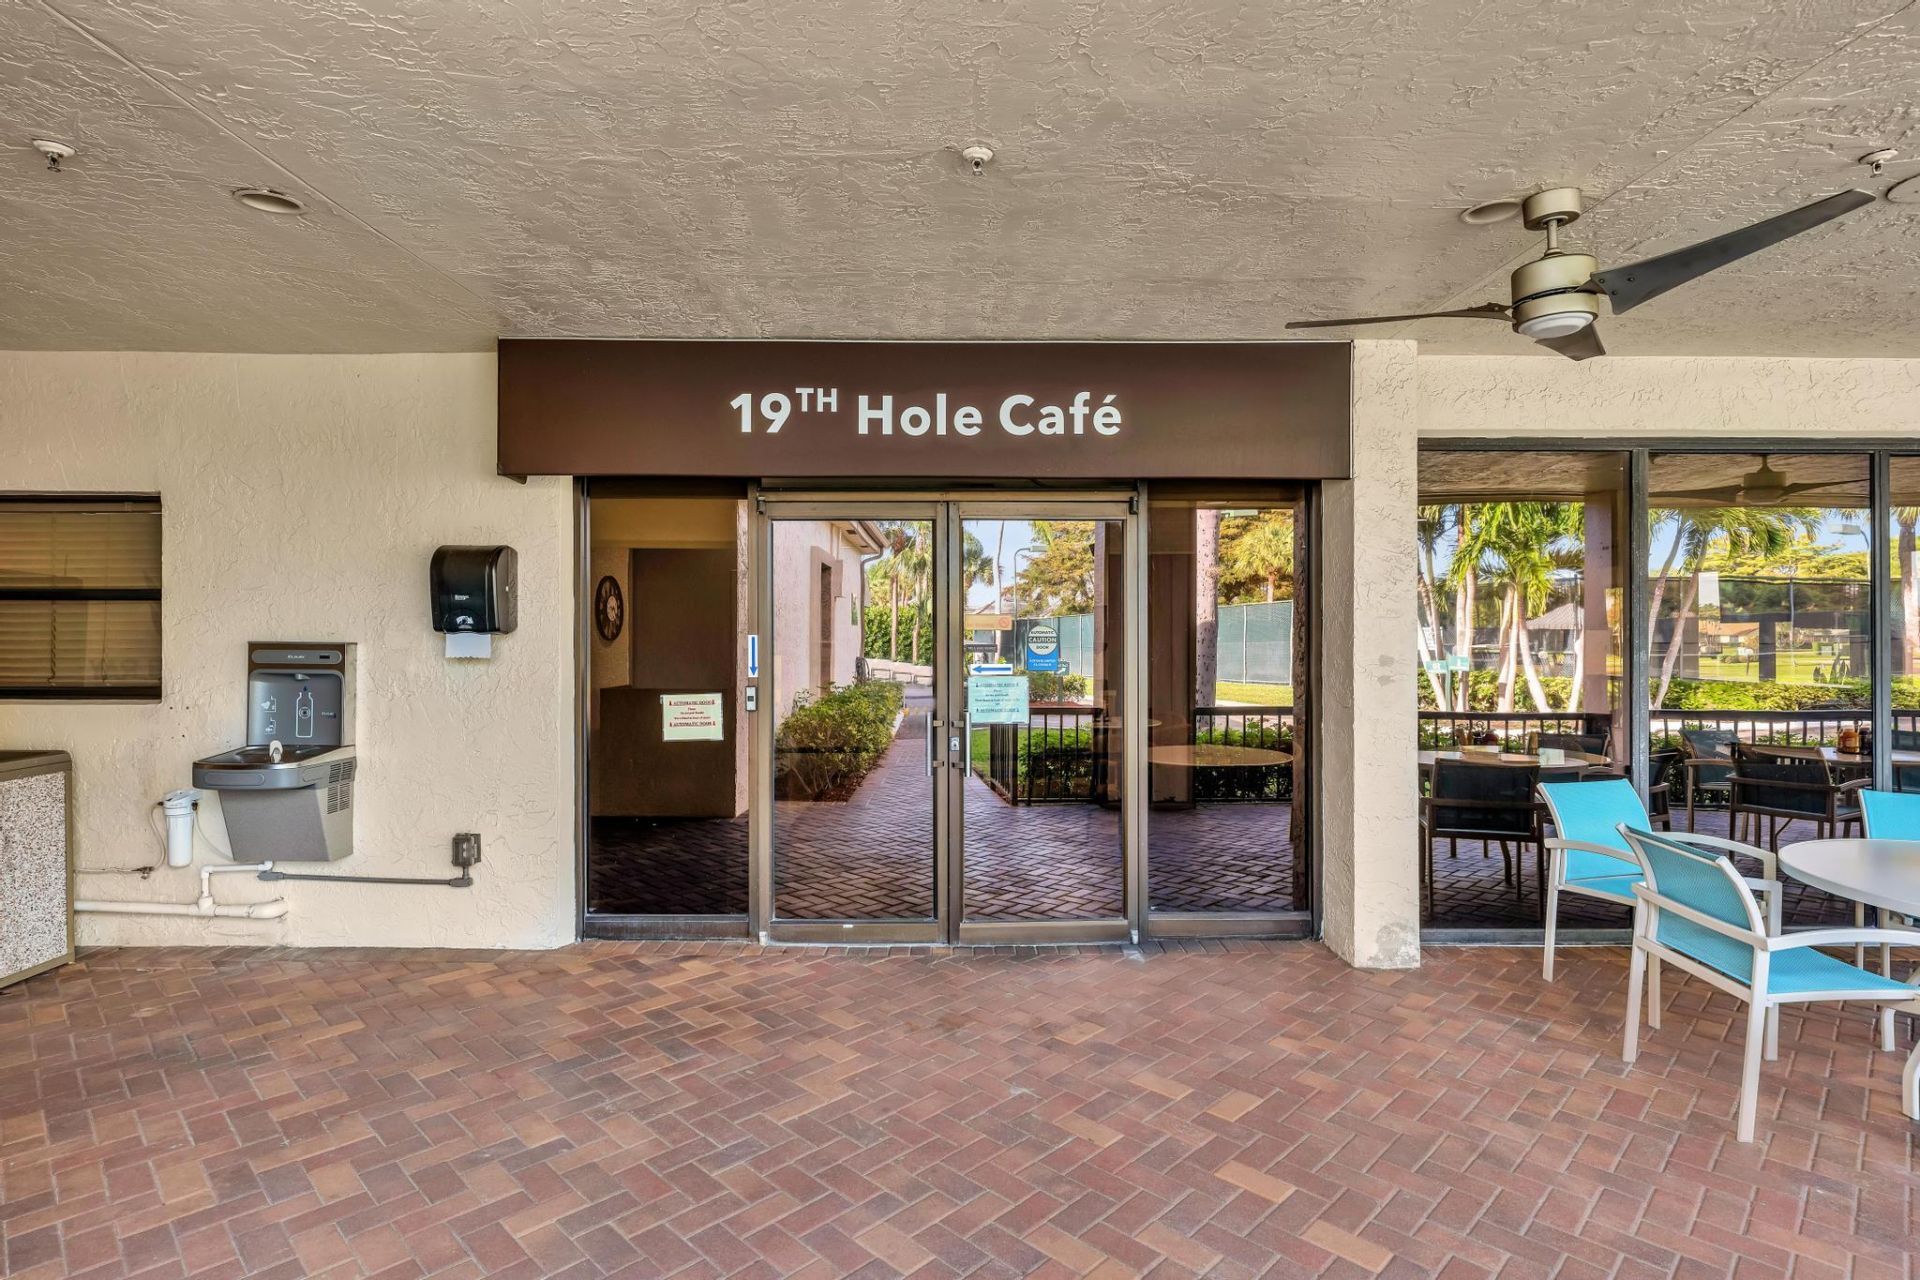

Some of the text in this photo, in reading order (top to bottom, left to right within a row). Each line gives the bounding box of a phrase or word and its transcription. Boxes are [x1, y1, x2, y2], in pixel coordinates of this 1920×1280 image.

[729, 387, 1122, 437] 19TH Hole Café
